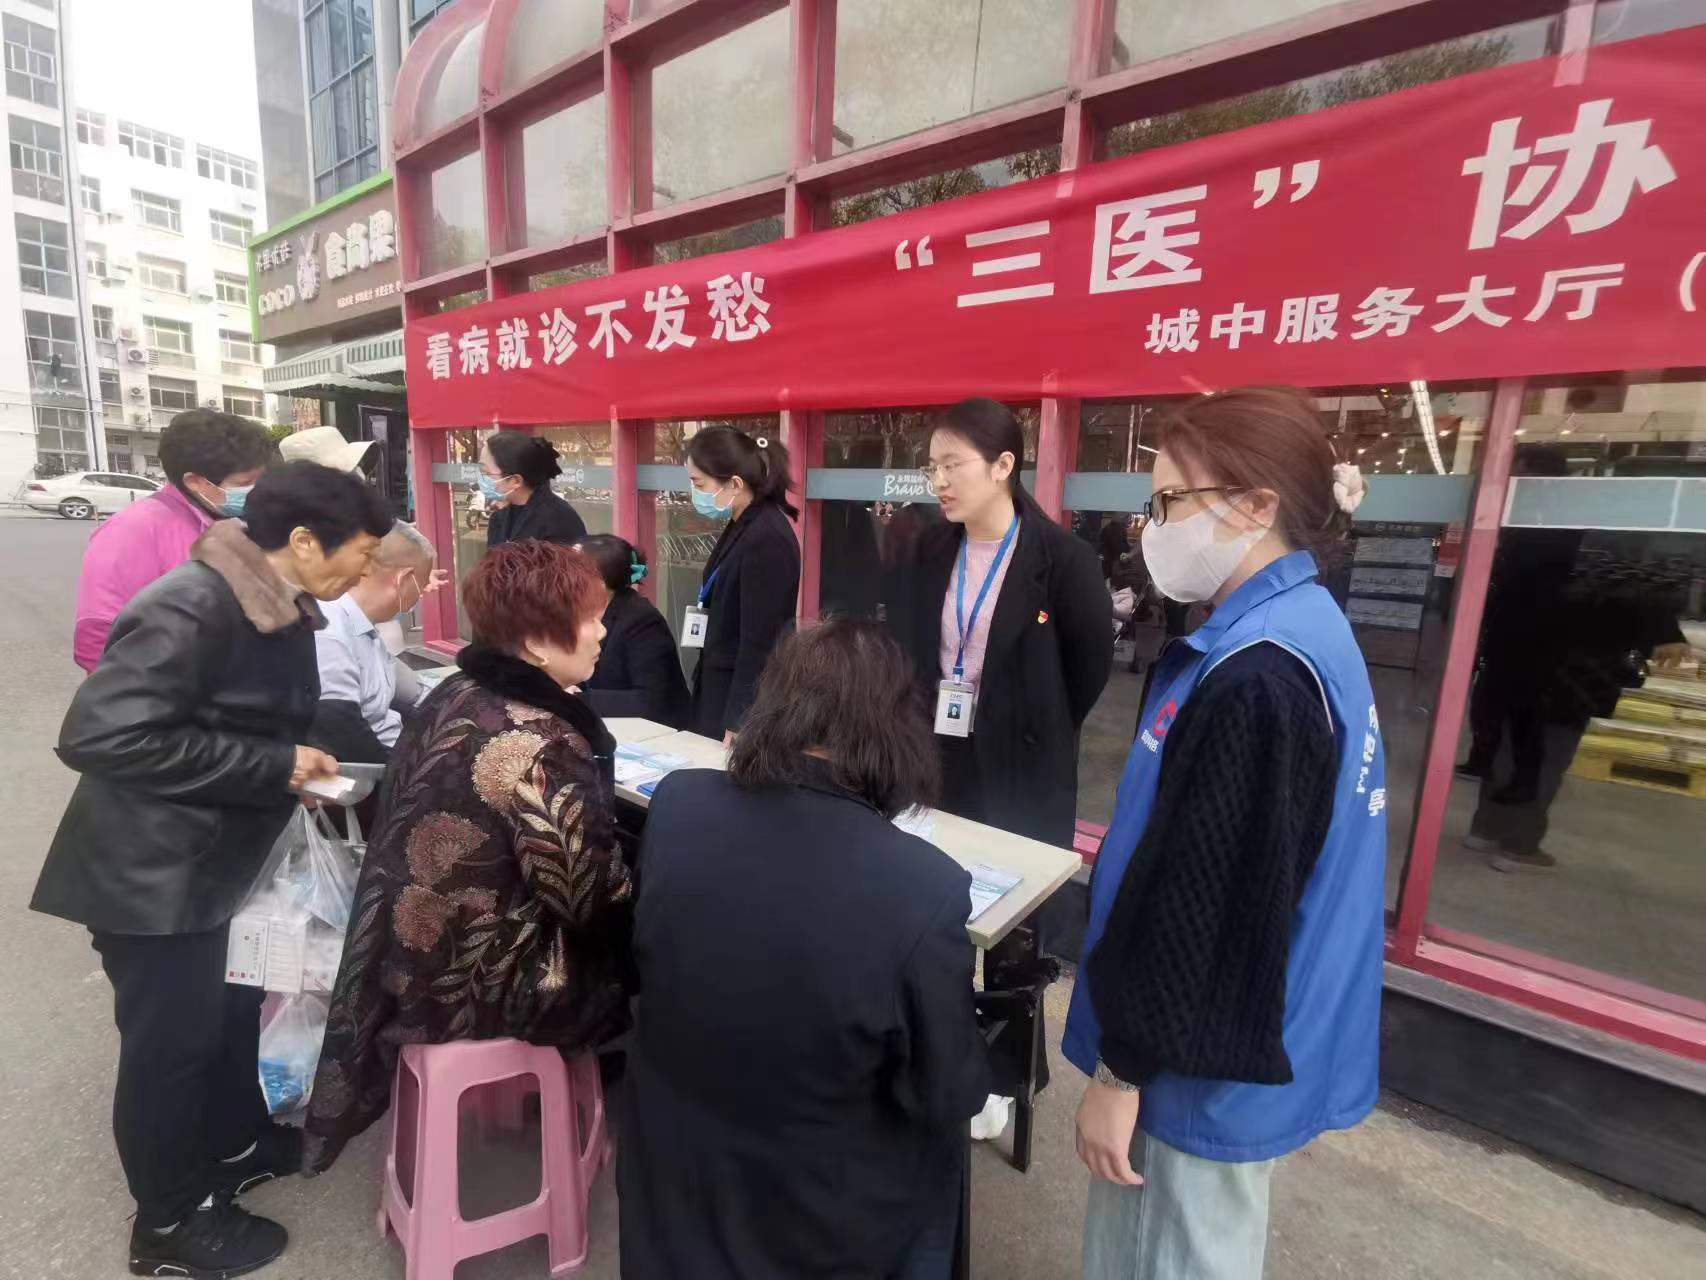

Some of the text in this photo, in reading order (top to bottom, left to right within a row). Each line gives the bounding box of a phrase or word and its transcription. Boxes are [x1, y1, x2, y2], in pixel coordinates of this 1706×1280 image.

[425, 271, 772, 380] 看病就诊不发愁
[1461, 98, 1677, 251] 协
[883, 474, 924, 496] Bravo
